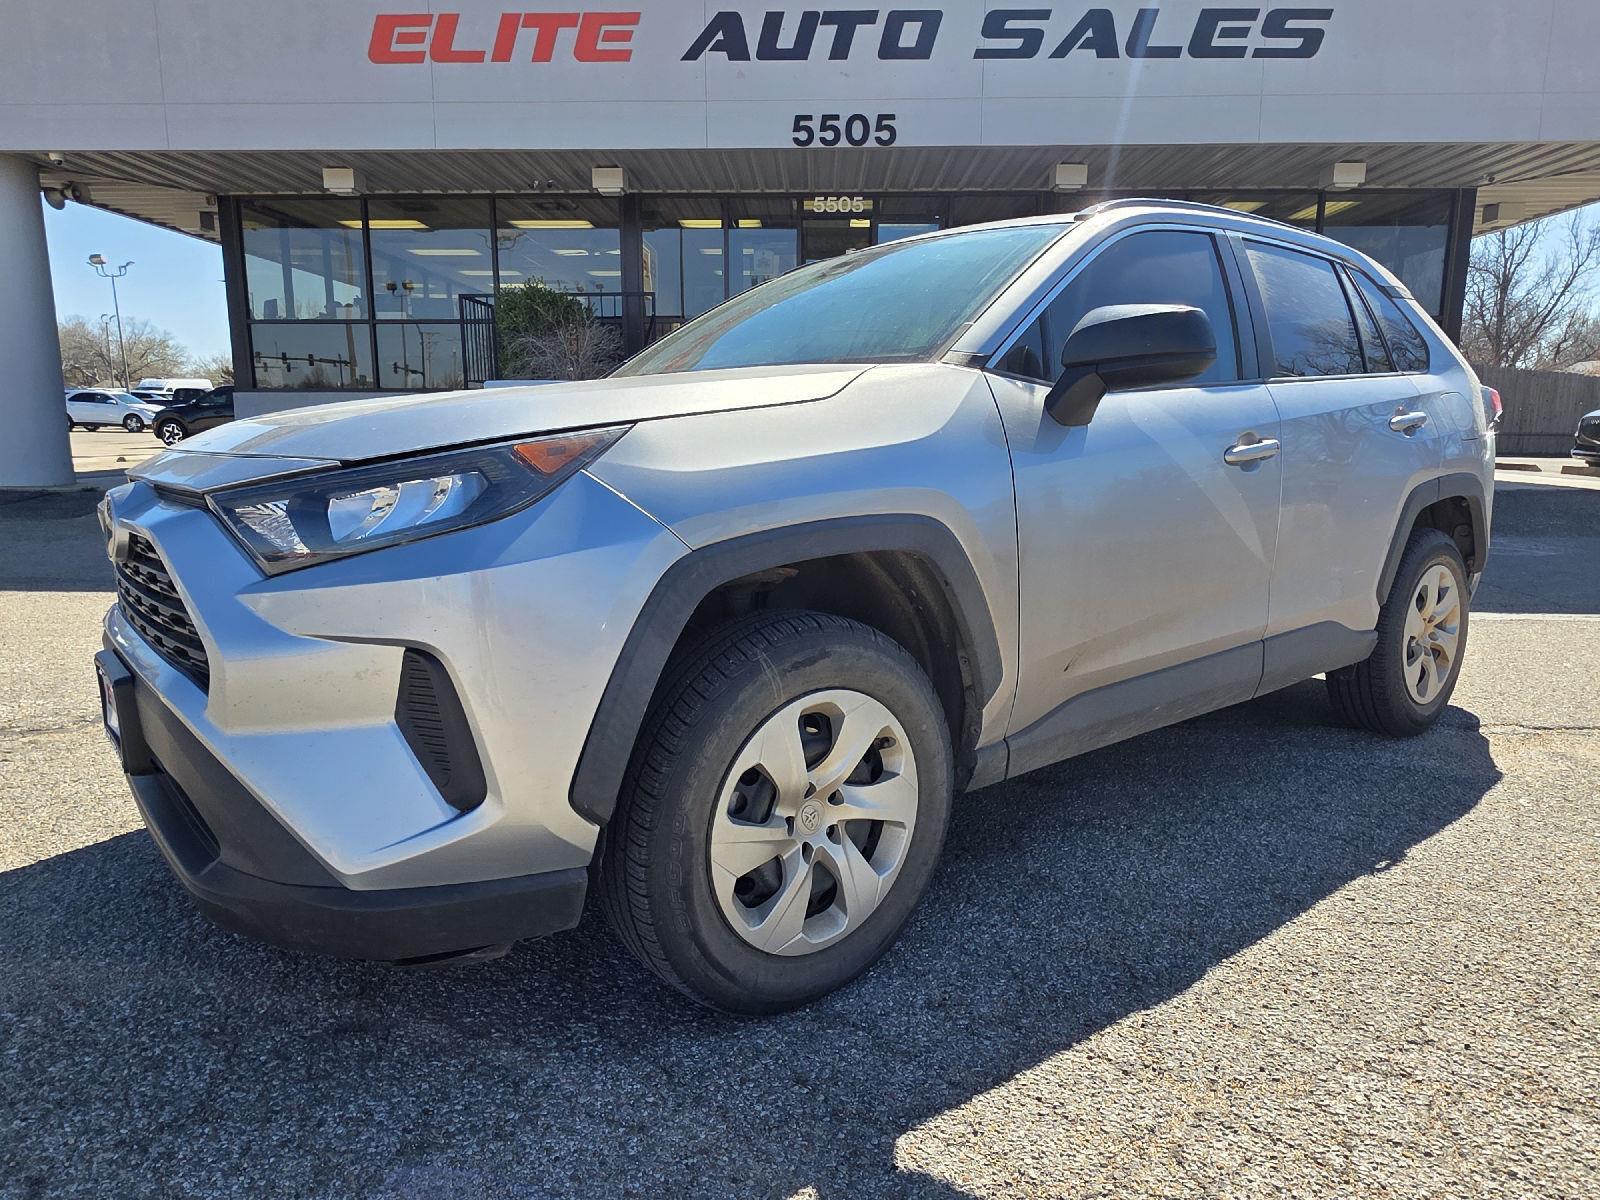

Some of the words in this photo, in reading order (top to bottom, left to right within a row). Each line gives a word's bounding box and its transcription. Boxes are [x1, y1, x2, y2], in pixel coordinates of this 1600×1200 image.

[367, 11, 642, 65] ELITE
[679, 8, 944, 62] AUTO
[972, 7, 1335, 61] SALES
[791, 113, 898, 148] 5505
[812, 196, 865, 213] 5505
